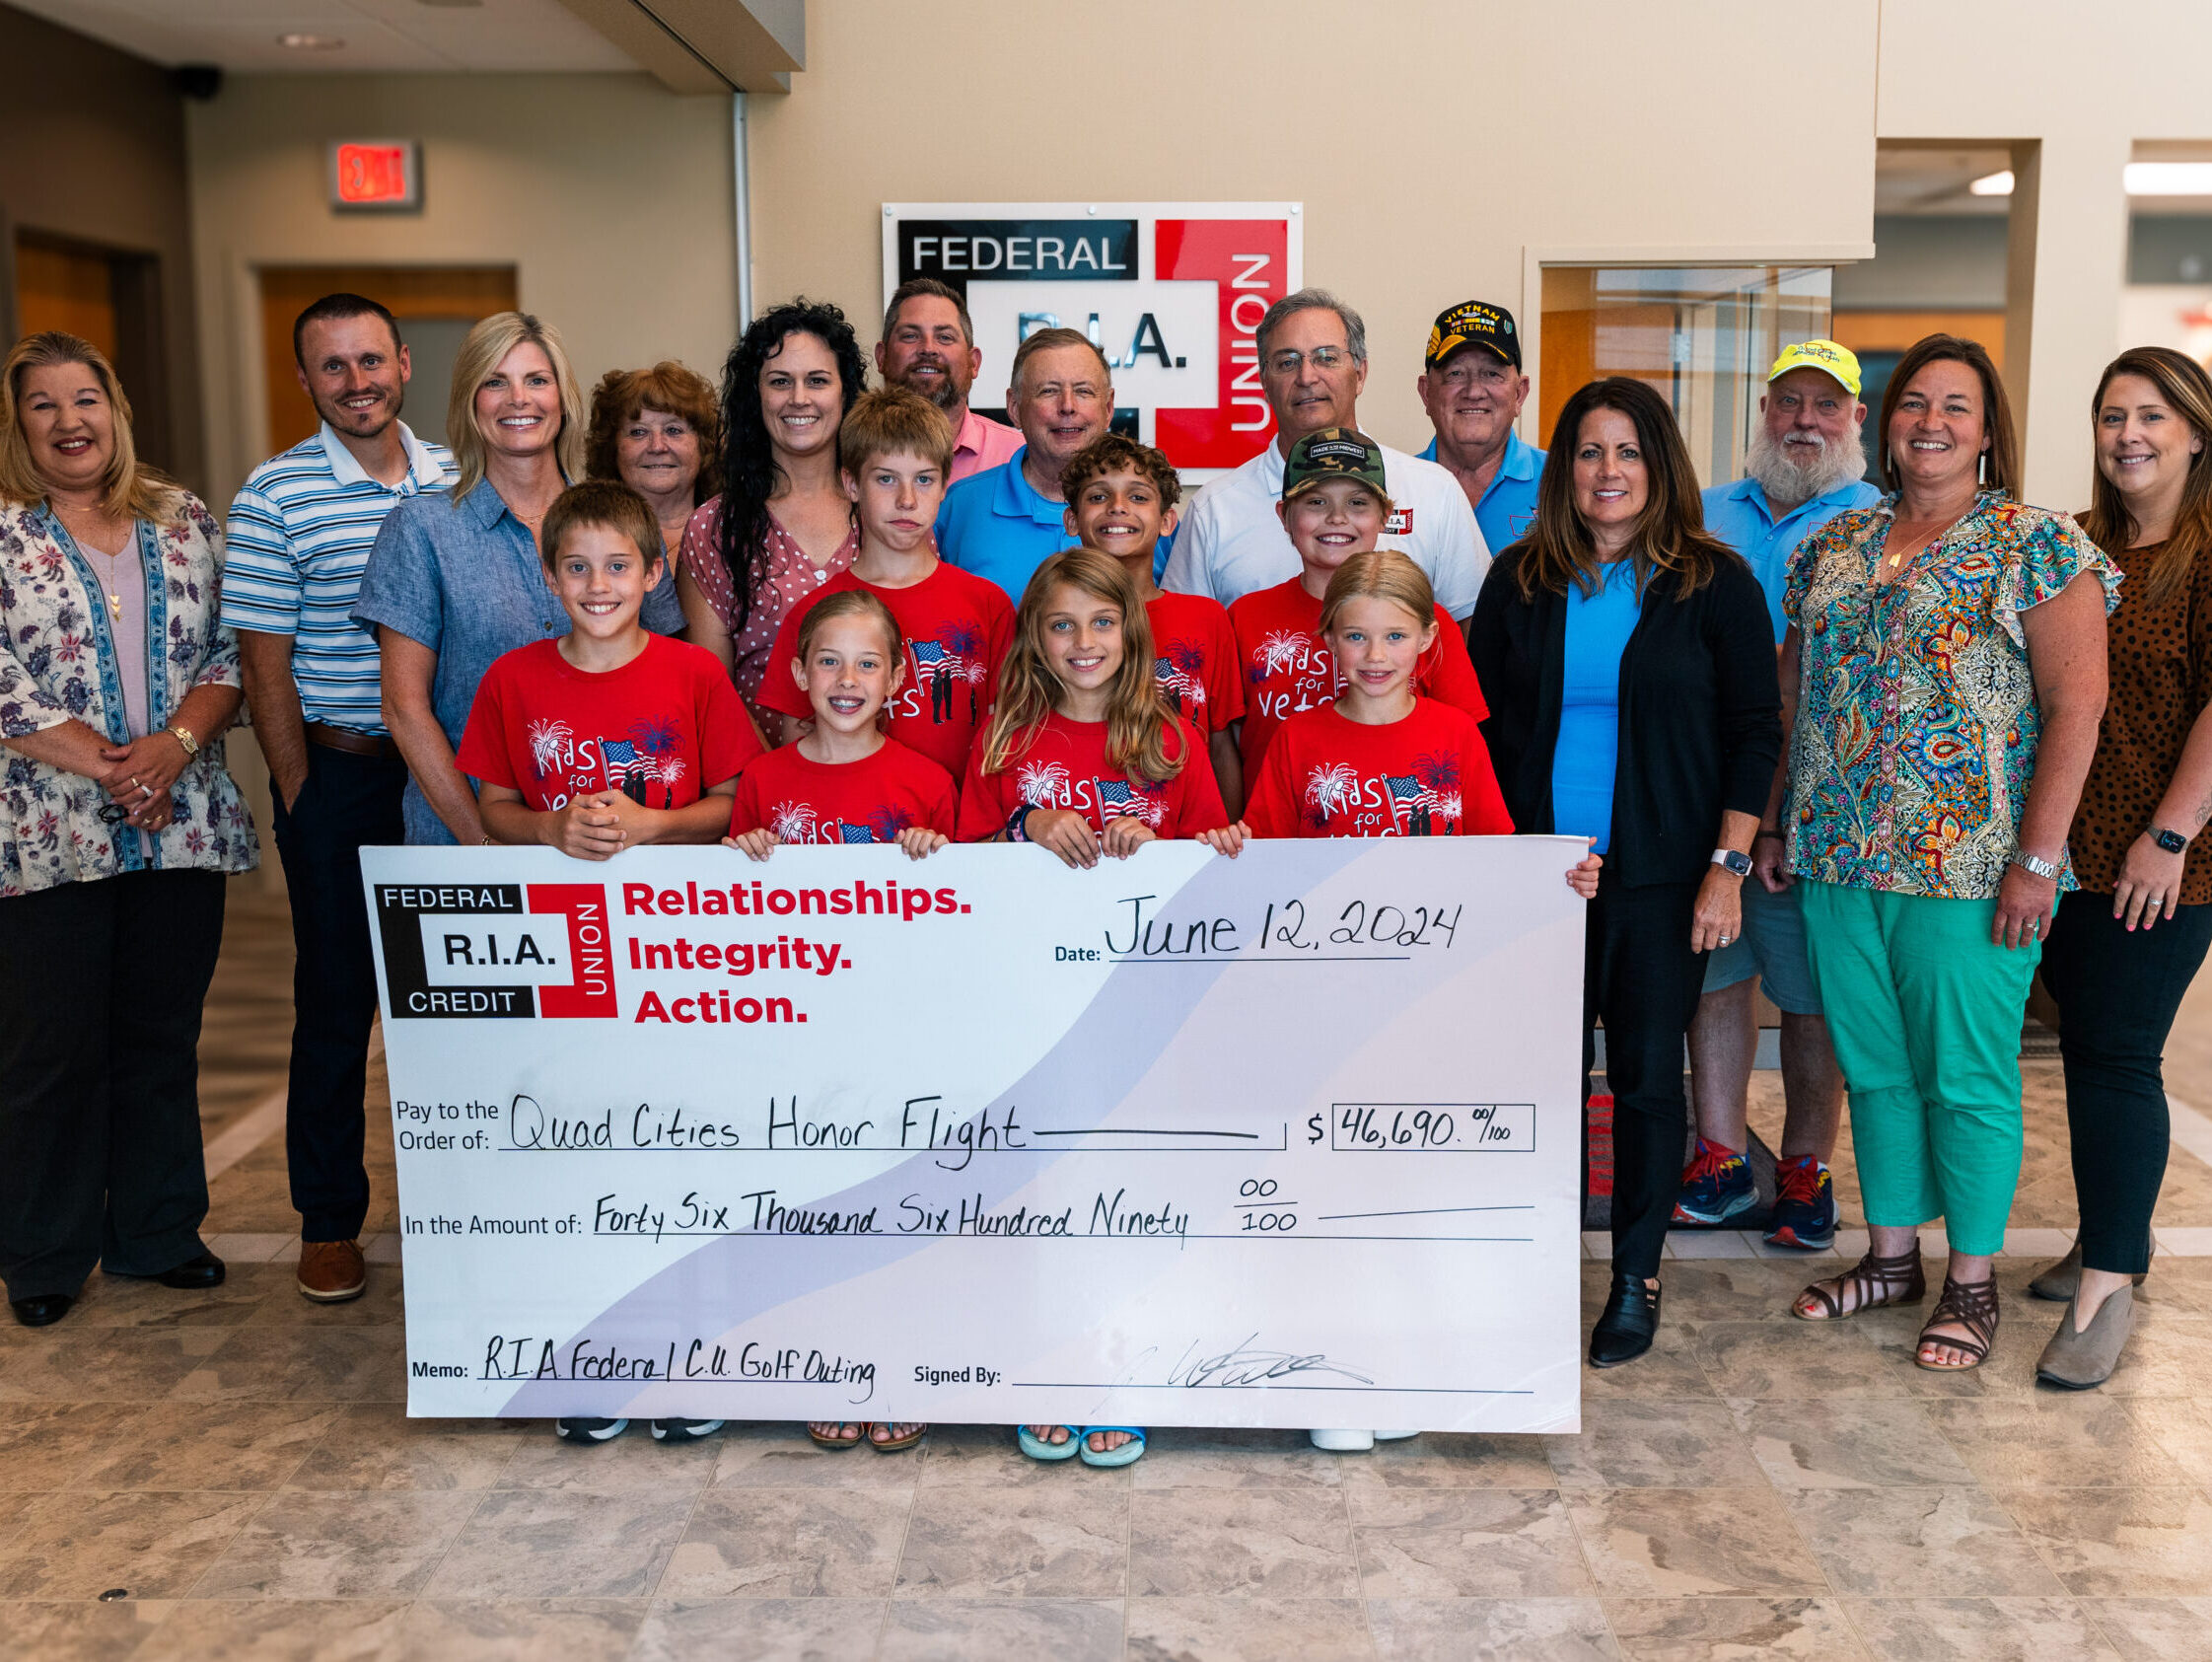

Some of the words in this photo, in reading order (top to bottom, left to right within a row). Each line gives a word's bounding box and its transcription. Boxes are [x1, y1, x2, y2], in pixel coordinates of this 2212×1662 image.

[913, 236, 1127, 271] FEDERAL
[1445, 305, 1501, 324] VIETNAM
[1450, 323, 1496, 335] VETERAN
[1230, 253, 1271, 433] UNION
[1313, 445, 1329, 454] MADE
[1265, 645, 1328, 678] Kids
[1295, 677, 1324, 695] for
[534, 737, 597, 777] Kids
[568, 773, 597, 795] for
[1318, 777, 1383, 821] Kids
[1353, 813, 1384, 833] for
[384, 888, 514, 909] FEDERAL
[621, 879, 973, 922] Relationships.
[1104, 895, 1241, 956] June
[1260, 899, 1320, 952] 12,
[1329, 899, 1463, 950] 2024
[445, 934, 556, 966] R.I.A.
[576, 903, 608, 996] UNION
[628, 935, 854, 977] Integrity.
[1054, 945, 1102, 963] Date:
[407, 991, 517, 1014] CREDIT
[634, 988, 809, 1024] Action.
[396, 1101, 432, 1124] Pay
[439, 1103, 461, 1120] to
[464, 1101, 499, 1120] the
[399, 1131, 458, 1150] Order
[462, 1130, 490, 1150] of:
[511, 1094, 613, 1151] Quad
[632, 1103, 741, 1149] Cities
[766, 1095, 875, 1150] Honor
[900, 1095, 1027, 1172] Flight
[1308, 1113, 1324, 1145] $
[405, 1215, 424, 1235] In
[429, 1215, 463, 1235] the
[468, 1215, 549, 1235] Amount
[554, 1214, 582, 1235] of:
[594, 1193, 666, 1245] Forty
[675, 1191, 730, 1231] Six
[740, 1190, 884, 1235] Thousand
[896, 1192, 949, 1234] Six
[959, 1192, 1074, 1238] Hundred
[1090, 1188, 1190, 1251] Ninety
[412, 1361, 468, 1378] Memo:
[570, 1337, 676, 1383] Federal
[741, 1341, 801, 1380] Golf
[802, 1349, 877, 1406] Outing
[913, 1365, 973, 1387] Signed
[976, 1367, 1002, 1387] By:
